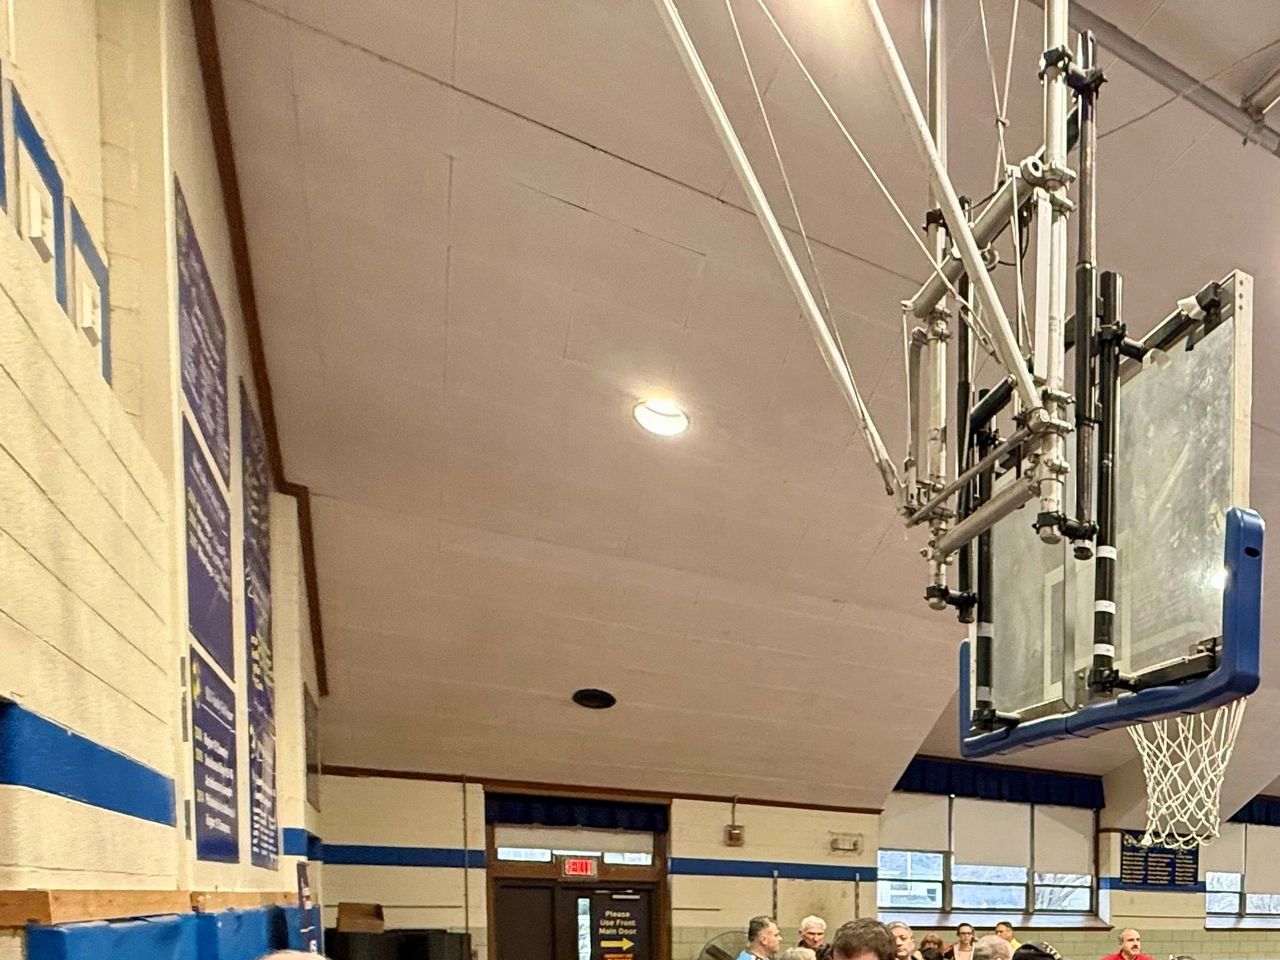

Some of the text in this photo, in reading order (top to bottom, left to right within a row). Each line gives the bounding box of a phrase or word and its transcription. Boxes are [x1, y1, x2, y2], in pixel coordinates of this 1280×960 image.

[604, 910, 631, 918] Please
[615, 919, 637, 927] Front
[598, 927, 637, 935] Main Door
